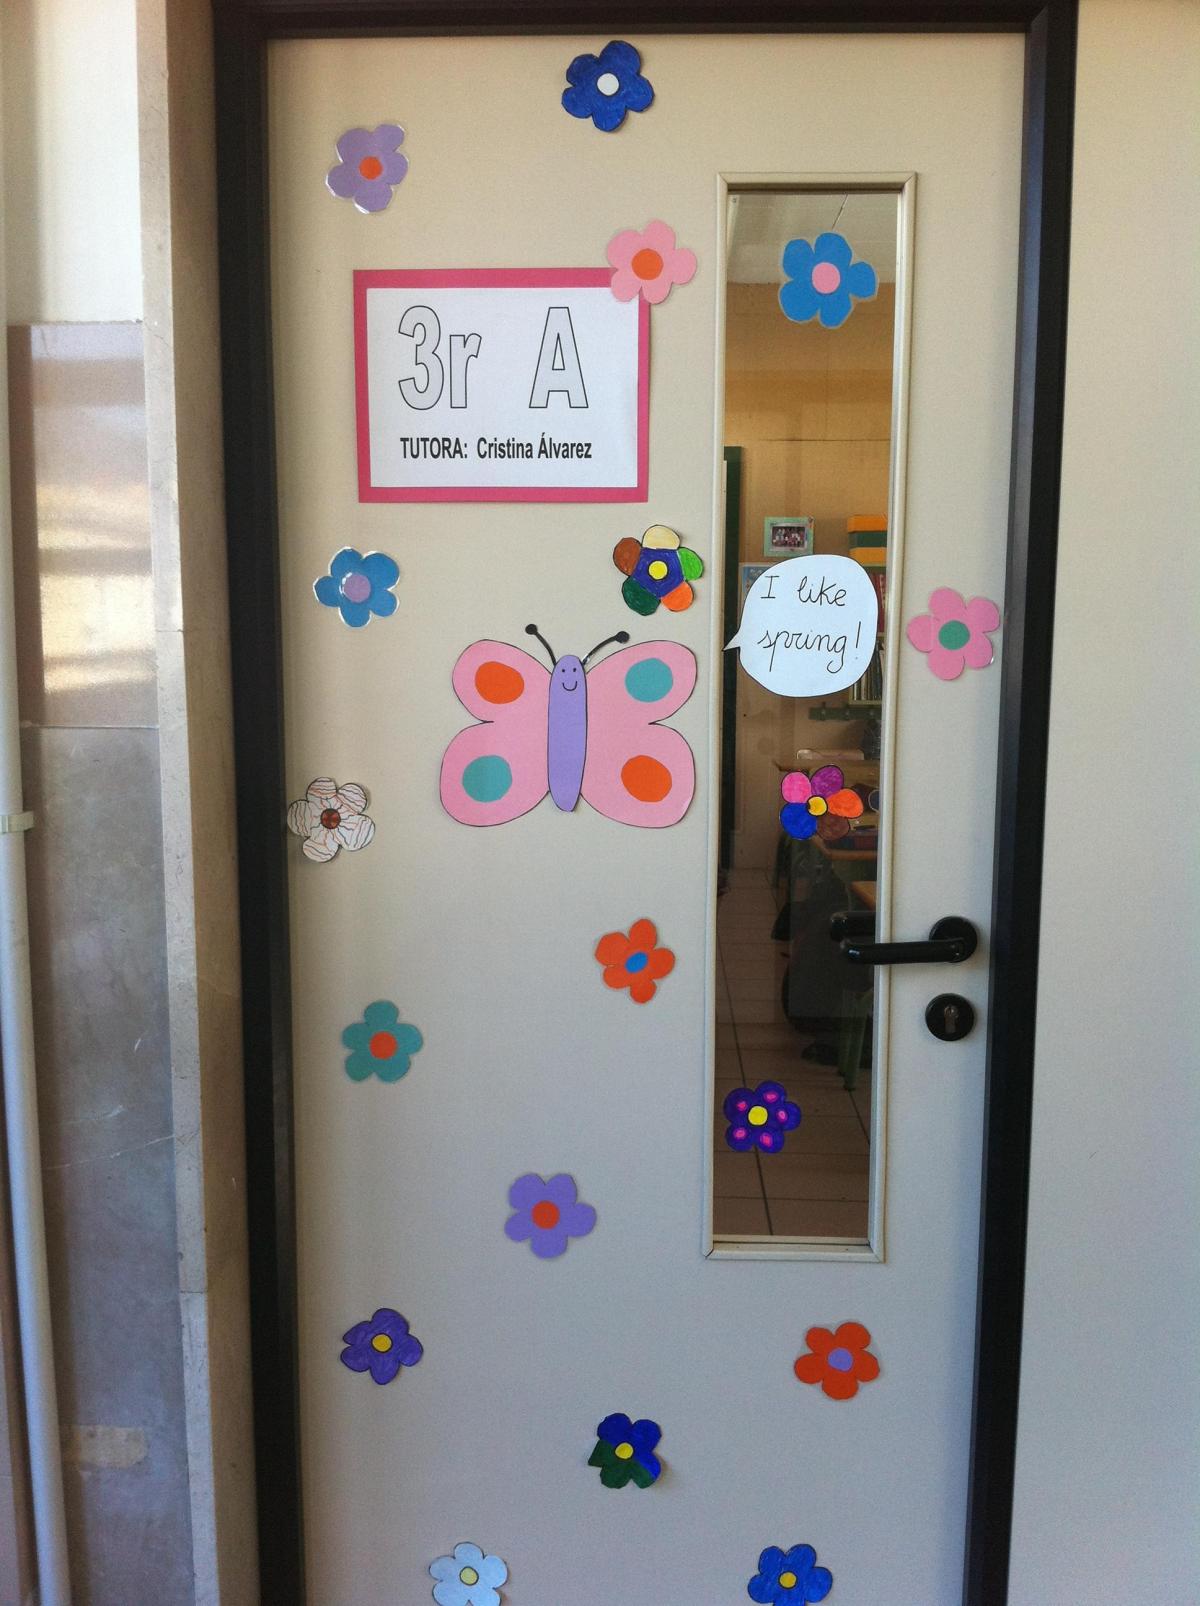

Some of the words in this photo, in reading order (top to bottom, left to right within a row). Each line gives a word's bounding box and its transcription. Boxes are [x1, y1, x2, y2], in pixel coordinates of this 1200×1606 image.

[398, 304, 482, 410] 3r
[529, 306, 589, 409] A
[400, 436, 468, 459] TUTORA:
[476, 436, 534, 459] Cristina
[537, 432, 592, 459] Álvarez
[760, 575, 780, 599] I
[796, 575, 847, 607] like
[757, 621, 862, 674] spring!
